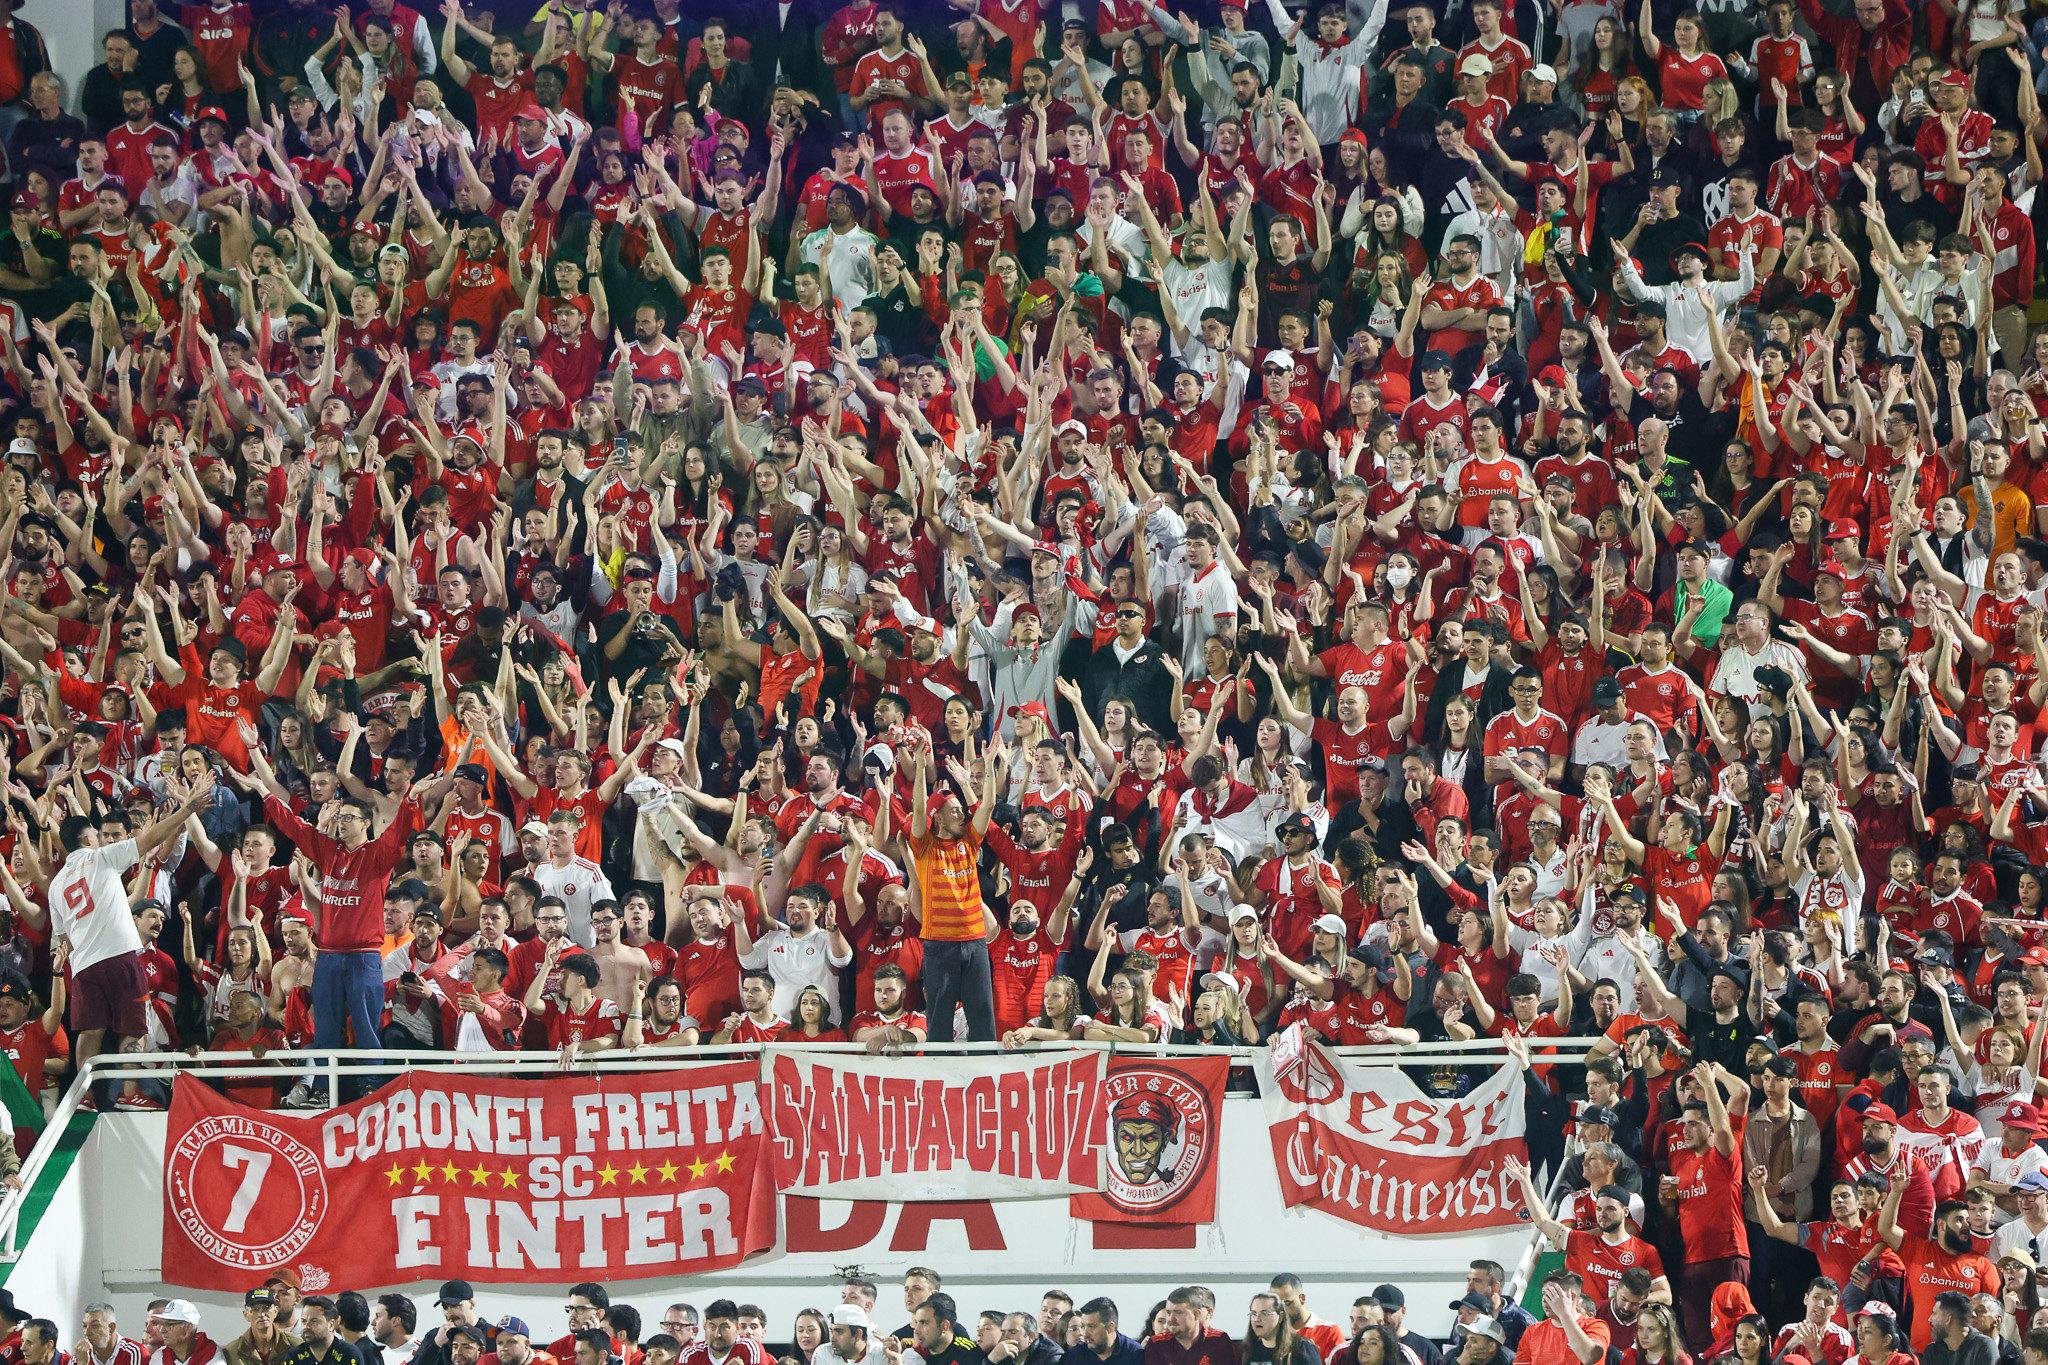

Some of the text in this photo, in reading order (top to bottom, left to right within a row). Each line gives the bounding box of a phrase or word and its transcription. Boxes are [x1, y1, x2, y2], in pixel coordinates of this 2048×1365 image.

[1820, 132, 1844, 141] risul
[1290, 379, 1309, 389] risul
[1478, 486, 1513, 496] banrisul
[1657, 489, 1677, 499] risul
[749, 597, 765, 609] risu
[1156, 950, 1178, 960] risul
[1792, 1077, 1831, 1089] Banrisul
[322, 1087, 561, 1170] CORONEL
[773, 1051, 1108, 1191] SANTA CRUZ
[179, 1118, 256, 1162] ACADEMIA
[282, 1140, 318, 1178] POVO
[528, 1155, 594, 1199] SC
[222, 1142, 273, 1233] 7
[391, 1185, 739, 1270] É INTER
[179, 1206, 316, 1266] CORONEL FREITAS
[1594, 1263, 1622, 1279] Banris
[1931, 1275, 1974, 1290] banrisul
